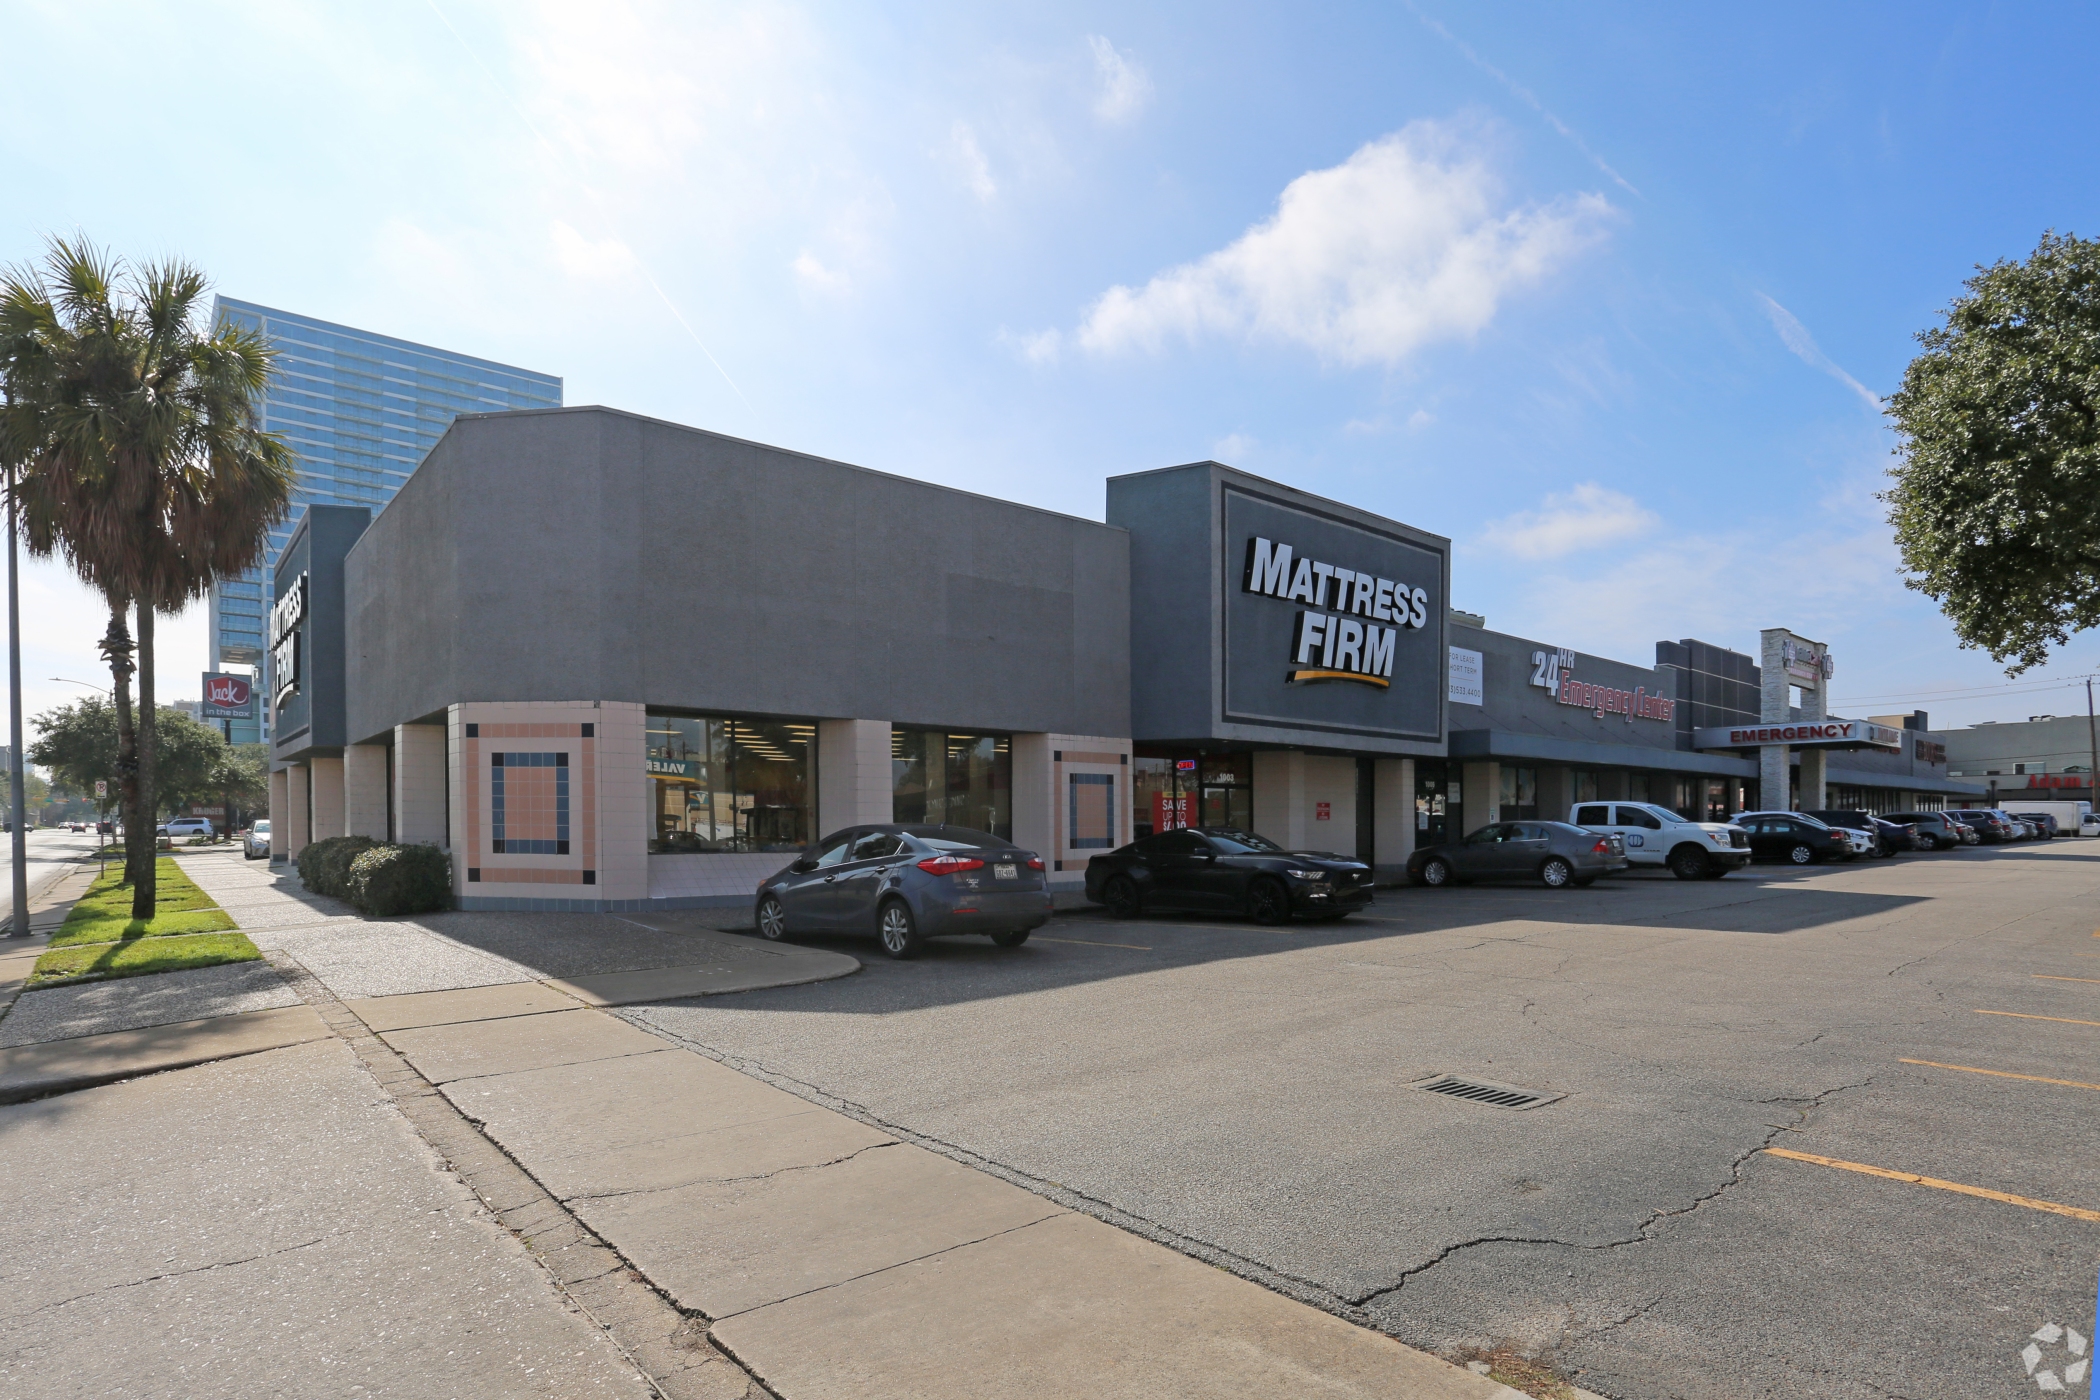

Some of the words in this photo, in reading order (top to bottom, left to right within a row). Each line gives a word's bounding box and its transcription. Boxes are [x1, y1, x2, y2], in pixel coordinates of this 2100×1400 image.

[1249, 536, 1428, 629] MATTRESS
[1297, 611, 1397, 677] FIRM
[276, 631, 294, 692] FIRM
[1449, 663, 1463, 673] HORT
[1460, 655, 1476, 665] LEASE
[1532, 650, 1559, 697] 24
[1559, 647, 1576, 668] HR
[208, 680, 248, 704] Jack
[1559, 669, 1636, 723] Emergency
[1637, 686, 1675, 722] Center
[216, 708, 231, 716] the
[232, 709, 250, 717] box
[1730, 723, 1853, 743] EMERGENCY
[1219, 773, 1234, 781] 1003
[2026, 773, 2082, 789] Adam
[1162, 799, 1187, 811] SAVE
[1162, 811, 1173, 821] UP
[1176, 811, 1187, 821] TO
